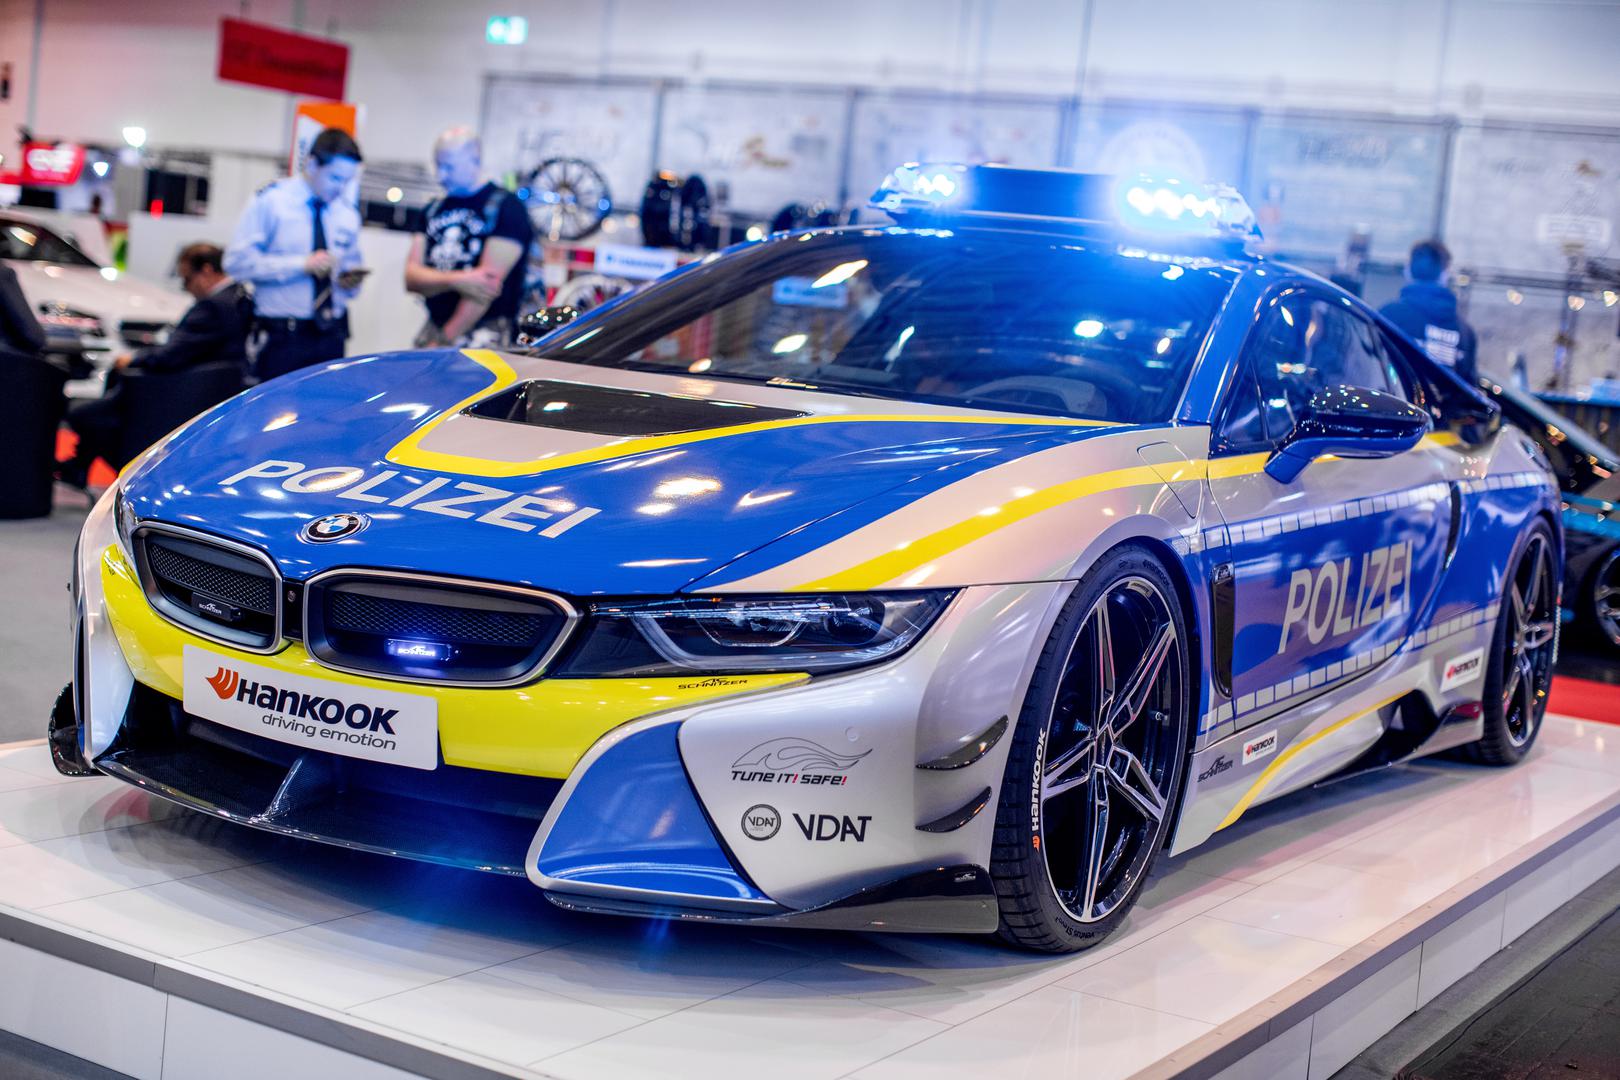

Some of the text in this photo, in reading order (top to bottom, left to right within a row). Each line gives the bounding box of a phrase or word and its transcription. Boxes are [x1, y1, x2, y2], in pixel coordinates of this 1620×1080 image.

[218, 459, 602, 539] POLIZEI
[1277, 539, 1413, 655] POLIZEI
[678, 679, 748, 690] SCHNITZER
[261, 713, 397, 751] driving emotion
[776, 773, 799, 784] IT!
[747, 816, 776, 828] VDAT
[792, 812, 873, 842] VDAT
